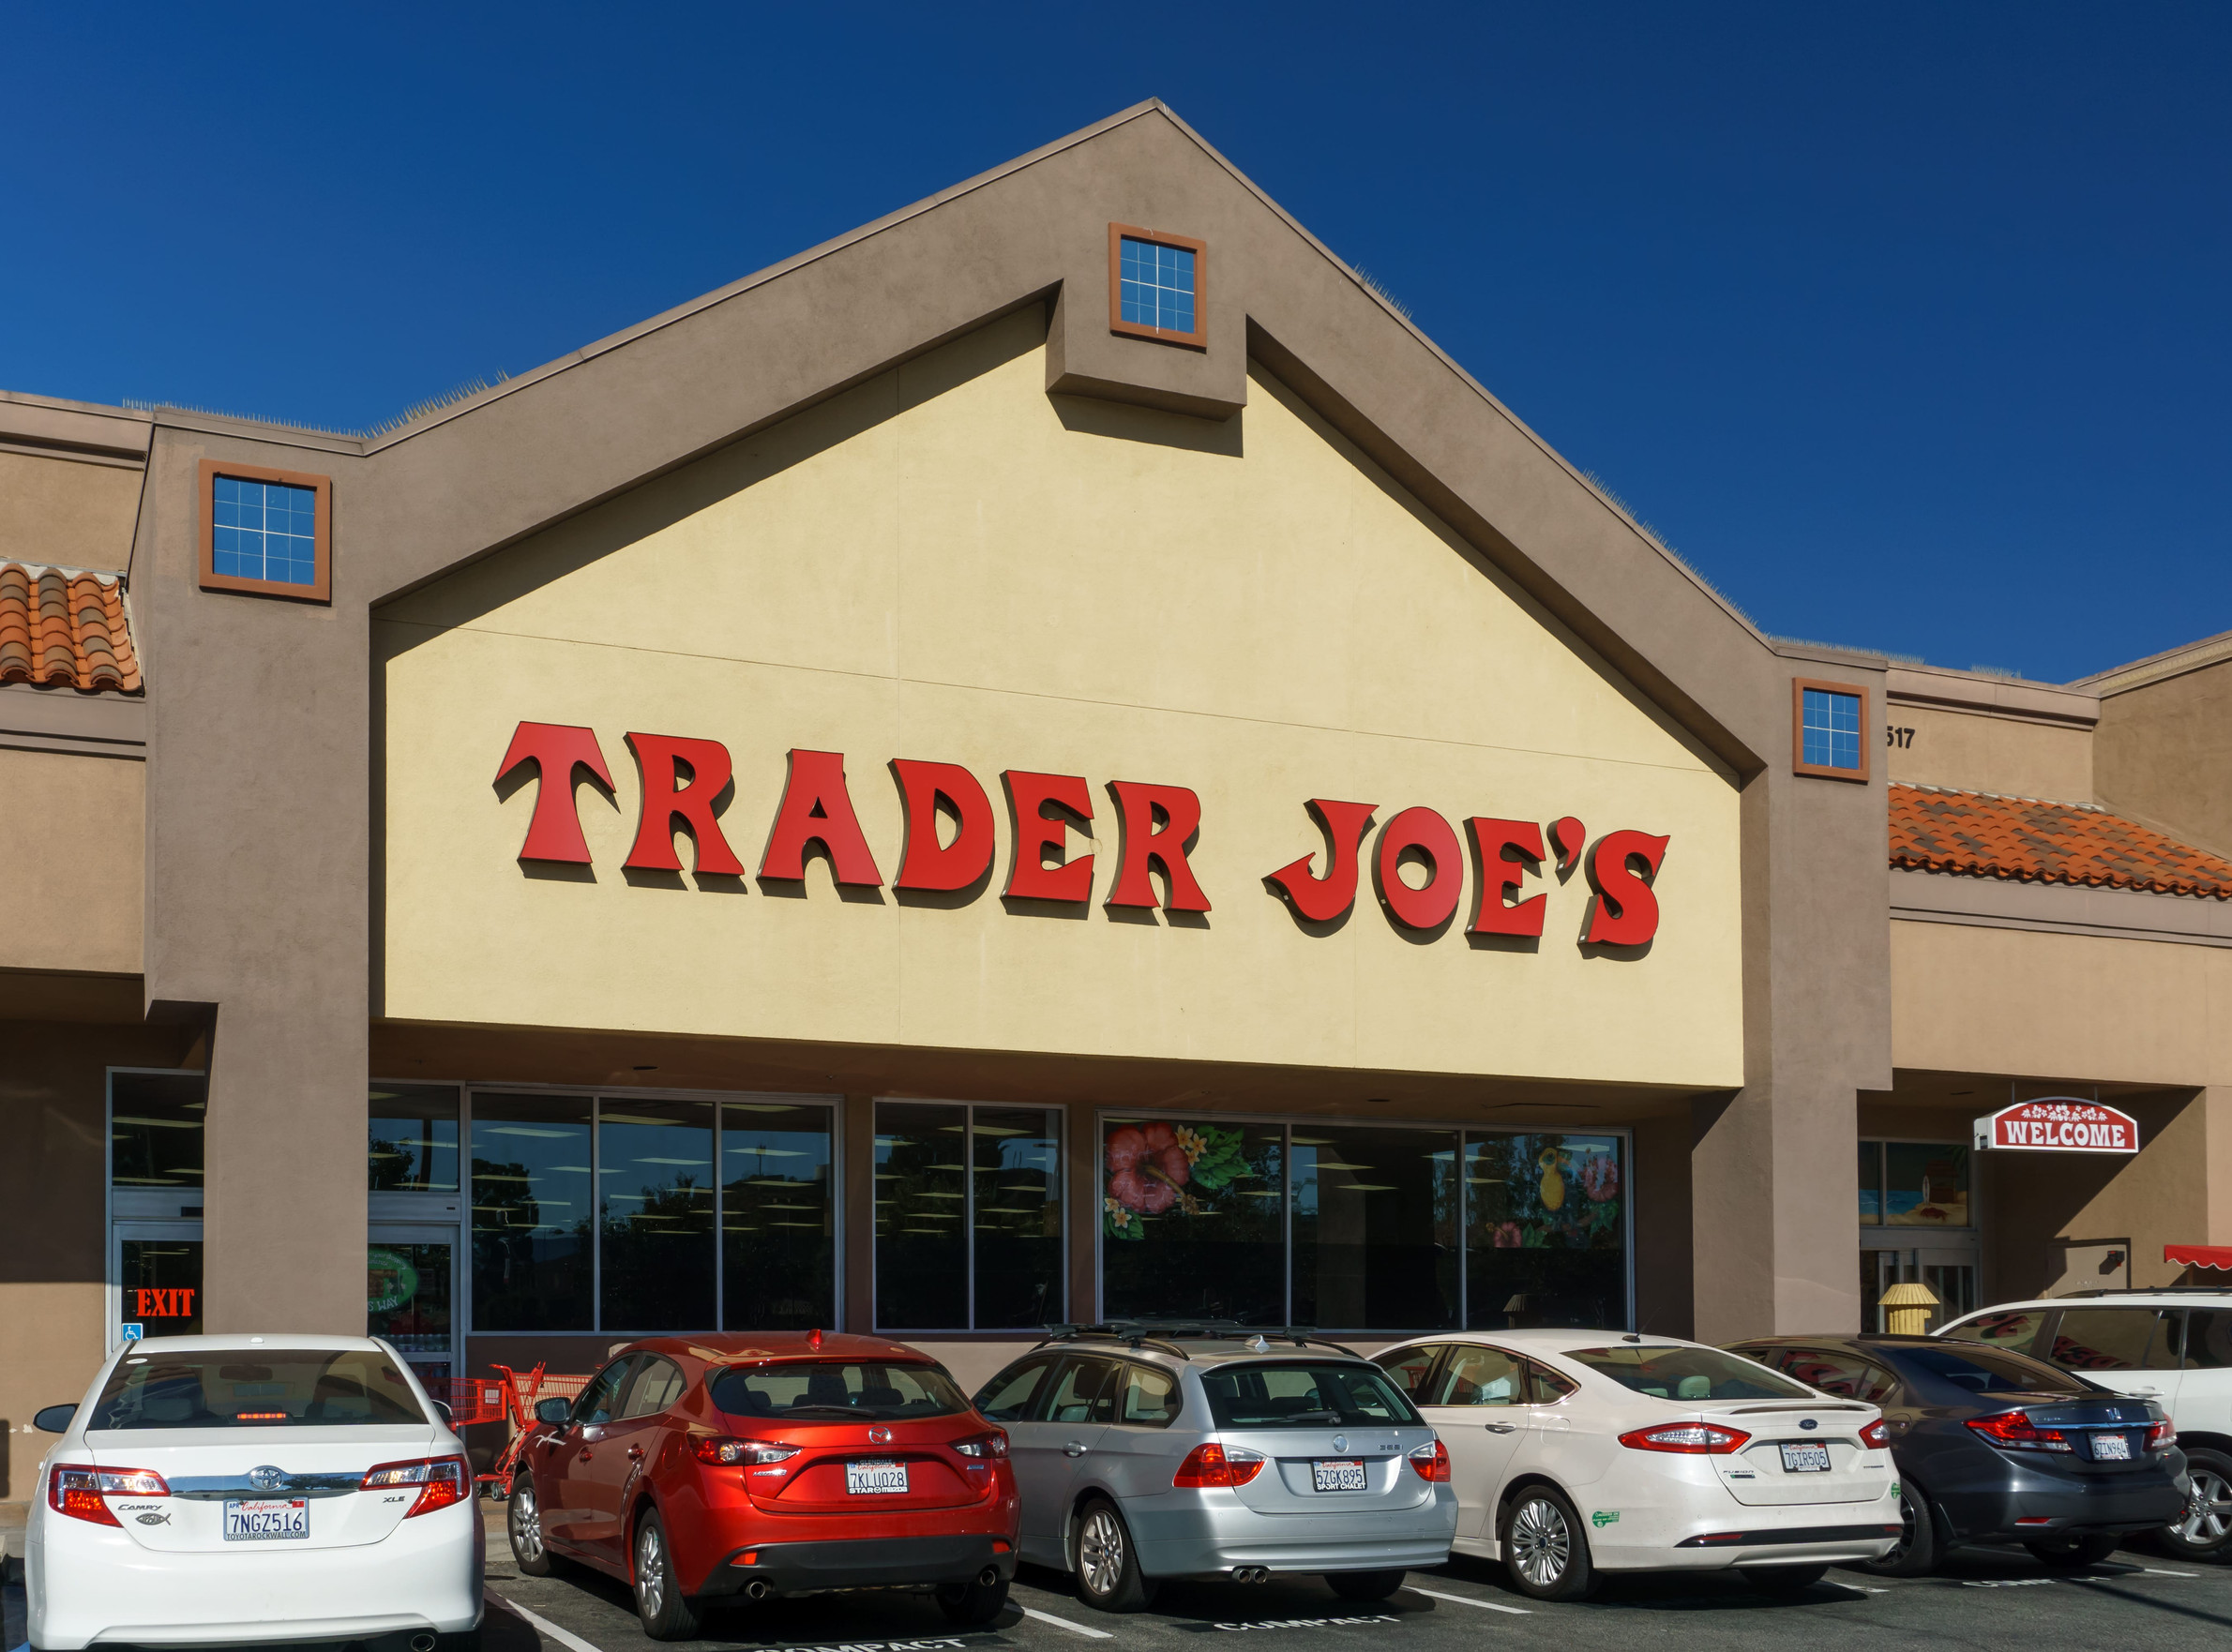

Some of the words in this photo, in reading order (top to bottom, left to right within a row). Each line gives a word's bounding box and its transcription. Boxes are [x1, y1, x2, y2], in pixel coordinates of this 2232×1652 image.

[492, 720, 1213, 913] TRADER
[1260, 797, 1671, 946] JOE'S
[2004, 1120, 2126, 1148] WELCOME
[136, 1288, 195, 1317] EXIT
[376, 1296, 399, 1311] WAY
[2094, 1442, 2127, 1455] 6ZIN964
[1785, 1451, 1827, 1466] 7GIR505
[850, 1472, 905, 1488] 7KLU028
[1316, 1469, 1363, 1485] 5ZGK895
[241, 1501, 294, 1513] California
[230, 1512, 303, 1533] 7NGZ516
[227, 1531, 307, 1540] TOYOTAROCKWALL.COM
[753, 1638, 967, 1652] MPACT
